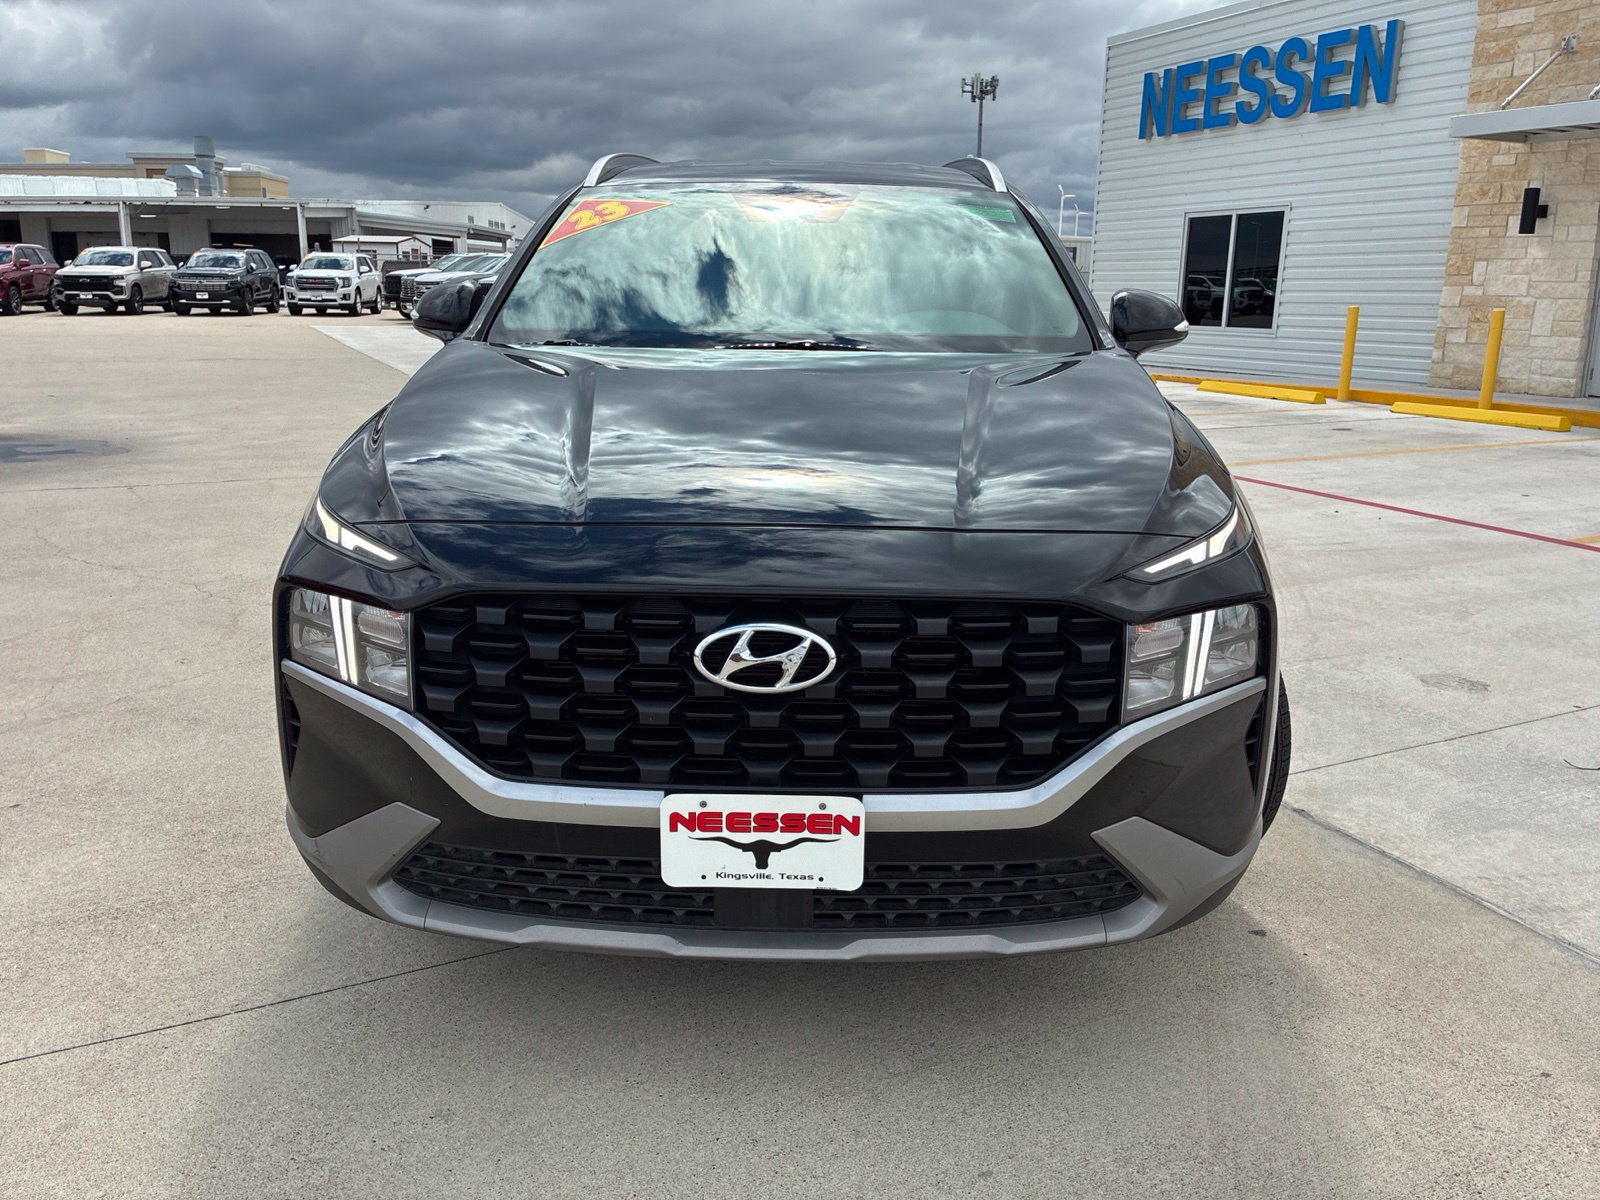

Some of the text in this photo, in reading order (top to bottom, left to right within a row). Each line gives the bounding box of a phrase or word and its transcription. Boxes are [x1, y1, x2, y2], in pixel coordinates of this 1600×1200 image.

[1138, 19, 1404, 140] NEESSEN
[568, 201, 631, 230] 23
[668, 811, 860, 837] NEESSEN
[779, 872, 814, 881] Texas
